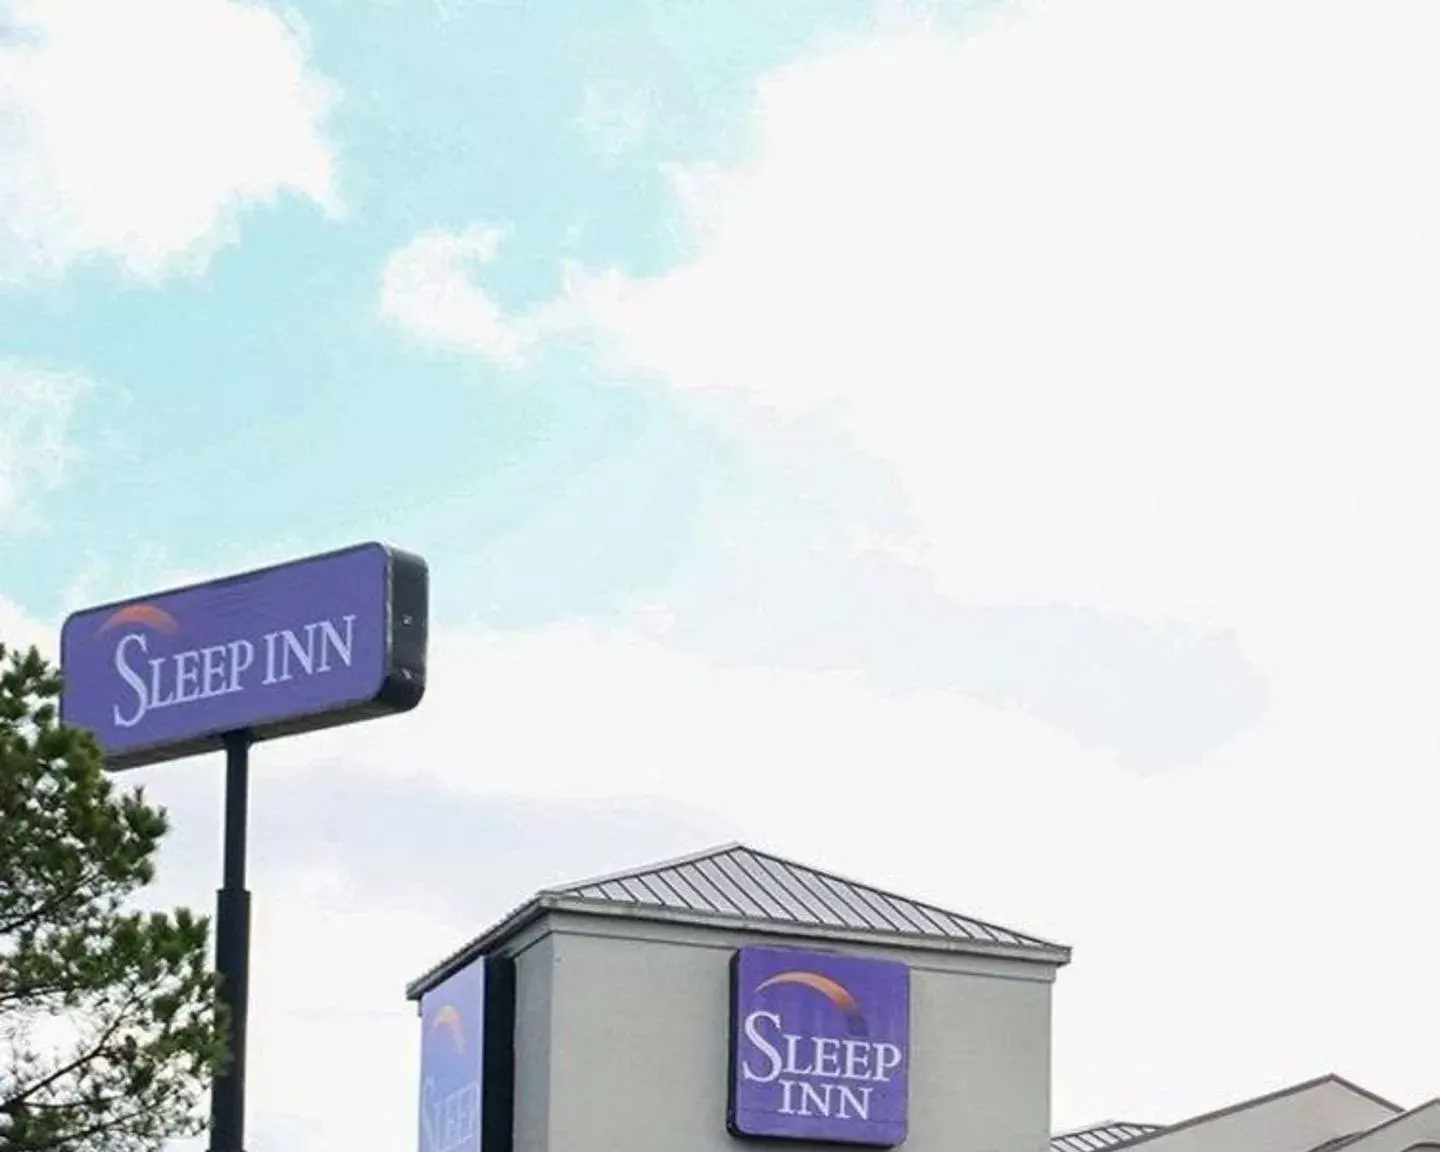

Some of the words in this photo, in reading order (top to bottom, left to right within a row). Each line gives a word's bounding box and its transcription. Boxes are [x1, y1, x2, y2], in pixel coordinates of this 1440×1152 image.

[113, 632, 254, 728] SLEEP
[261, 613, 358, 687] INN
[742, 1010, 902, 1083] SLEEP
[777, 1078, 874, 1121] INN
